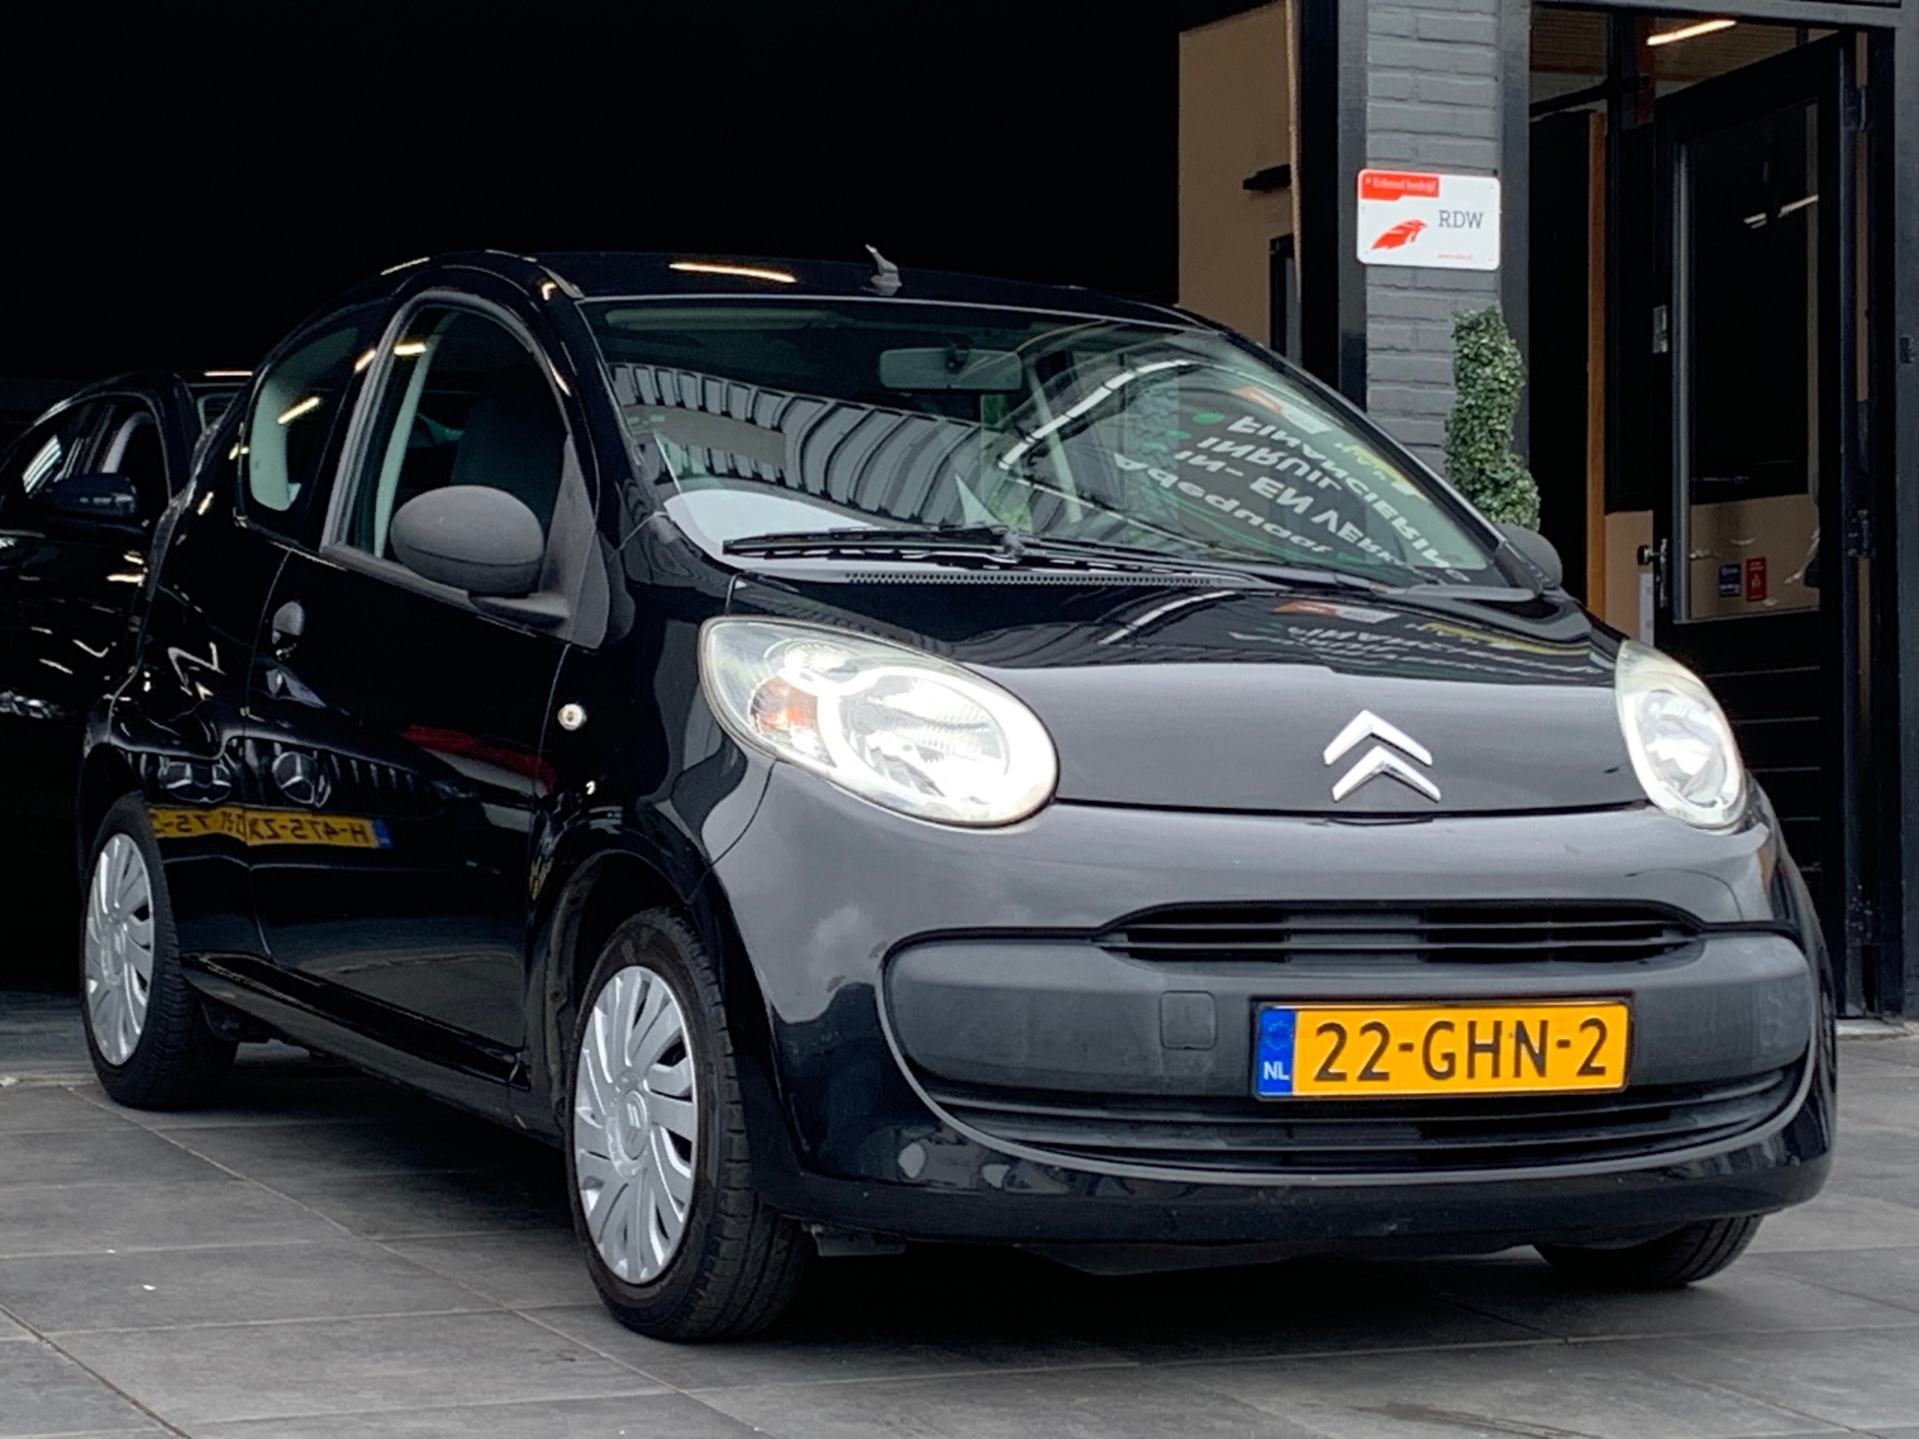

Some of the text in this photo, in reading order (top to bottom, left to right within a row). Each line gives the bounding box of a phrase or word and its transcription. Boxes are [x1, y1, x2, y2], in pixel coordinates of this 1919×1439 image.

[1438, 209, 1484, 229] RDW
[1263, 1016, 1609, 1083] NL 22-GHN-2
